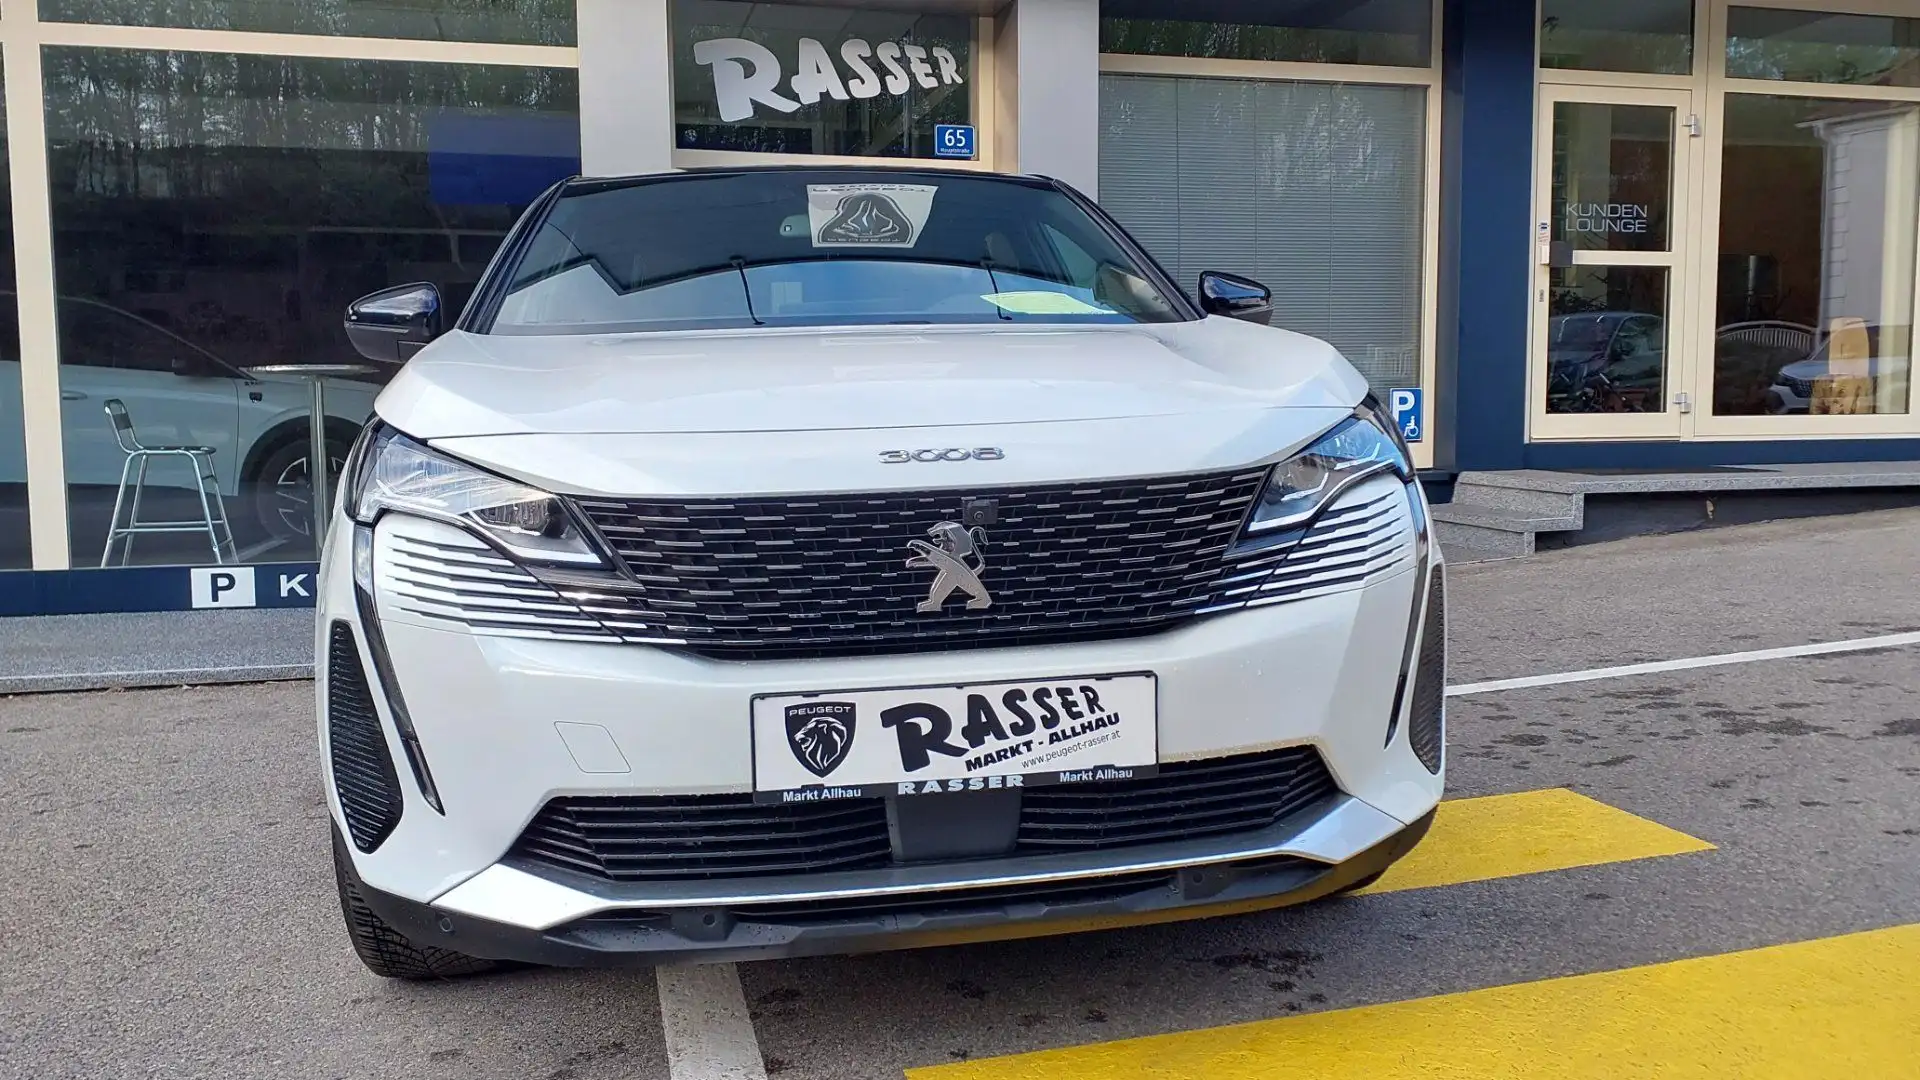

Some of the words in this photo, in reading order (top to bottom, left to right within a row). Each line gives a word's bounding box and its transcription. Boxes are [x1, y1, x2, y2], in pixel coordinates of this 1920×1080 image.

[693, 37, 964, 123] RASSER
[945, 129, 966, 147] 65
[1565, 203, 1648, 218] KUNDEN
[1565, 218, 1647, 233] LOUNGE
[1392, 391, 1415, 421] P
[879, 447, 1005, 464] 3008
[210, 573, 236, 603] P
[280, 573, 320, 598] K
[789, 705, 852, 717] PEUGEOT
[880, 685, 1105, 773] RASSER
[965, 739, 1034, 772] MARKT
[1049, 712, 1120, 745] ALLHAU
[1021, 729, 1121, 769] www.peugeot-rasser.at
[898, 775, 1024, 795] RASSER
[1059, 771, 1093, 783] Markt
[1095, 768, 1133, 780] Allhau
[783, 790, 819, 802] Markt
[821, 787, 862, 799] Allhau
